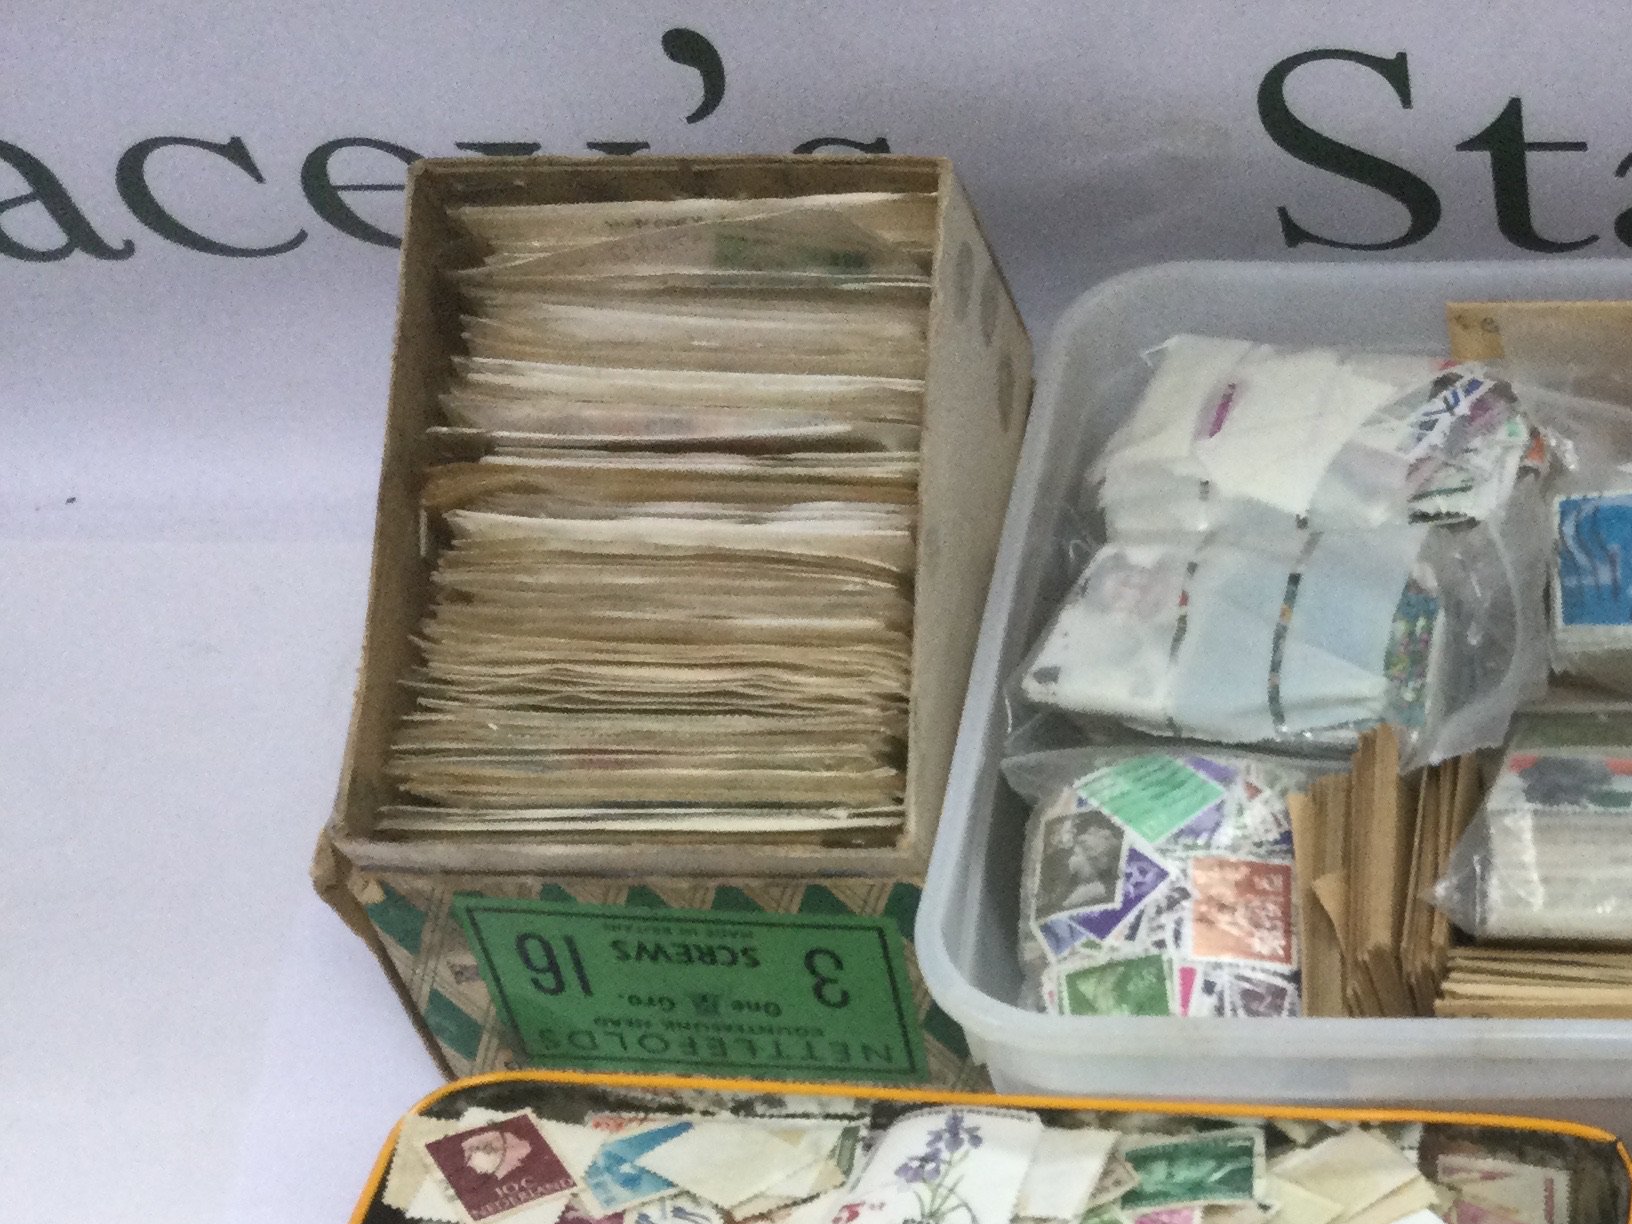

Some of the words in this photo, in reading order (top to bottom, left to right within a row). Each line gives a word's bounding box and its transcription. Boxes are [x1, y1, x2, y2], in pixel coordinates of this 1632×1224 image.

[514, 932, 594, 1001] 16
[609, 939, 762, 970] SCREWS
[803, 947, 851, 1010] 3
[730, 999, 783, 1019] One
